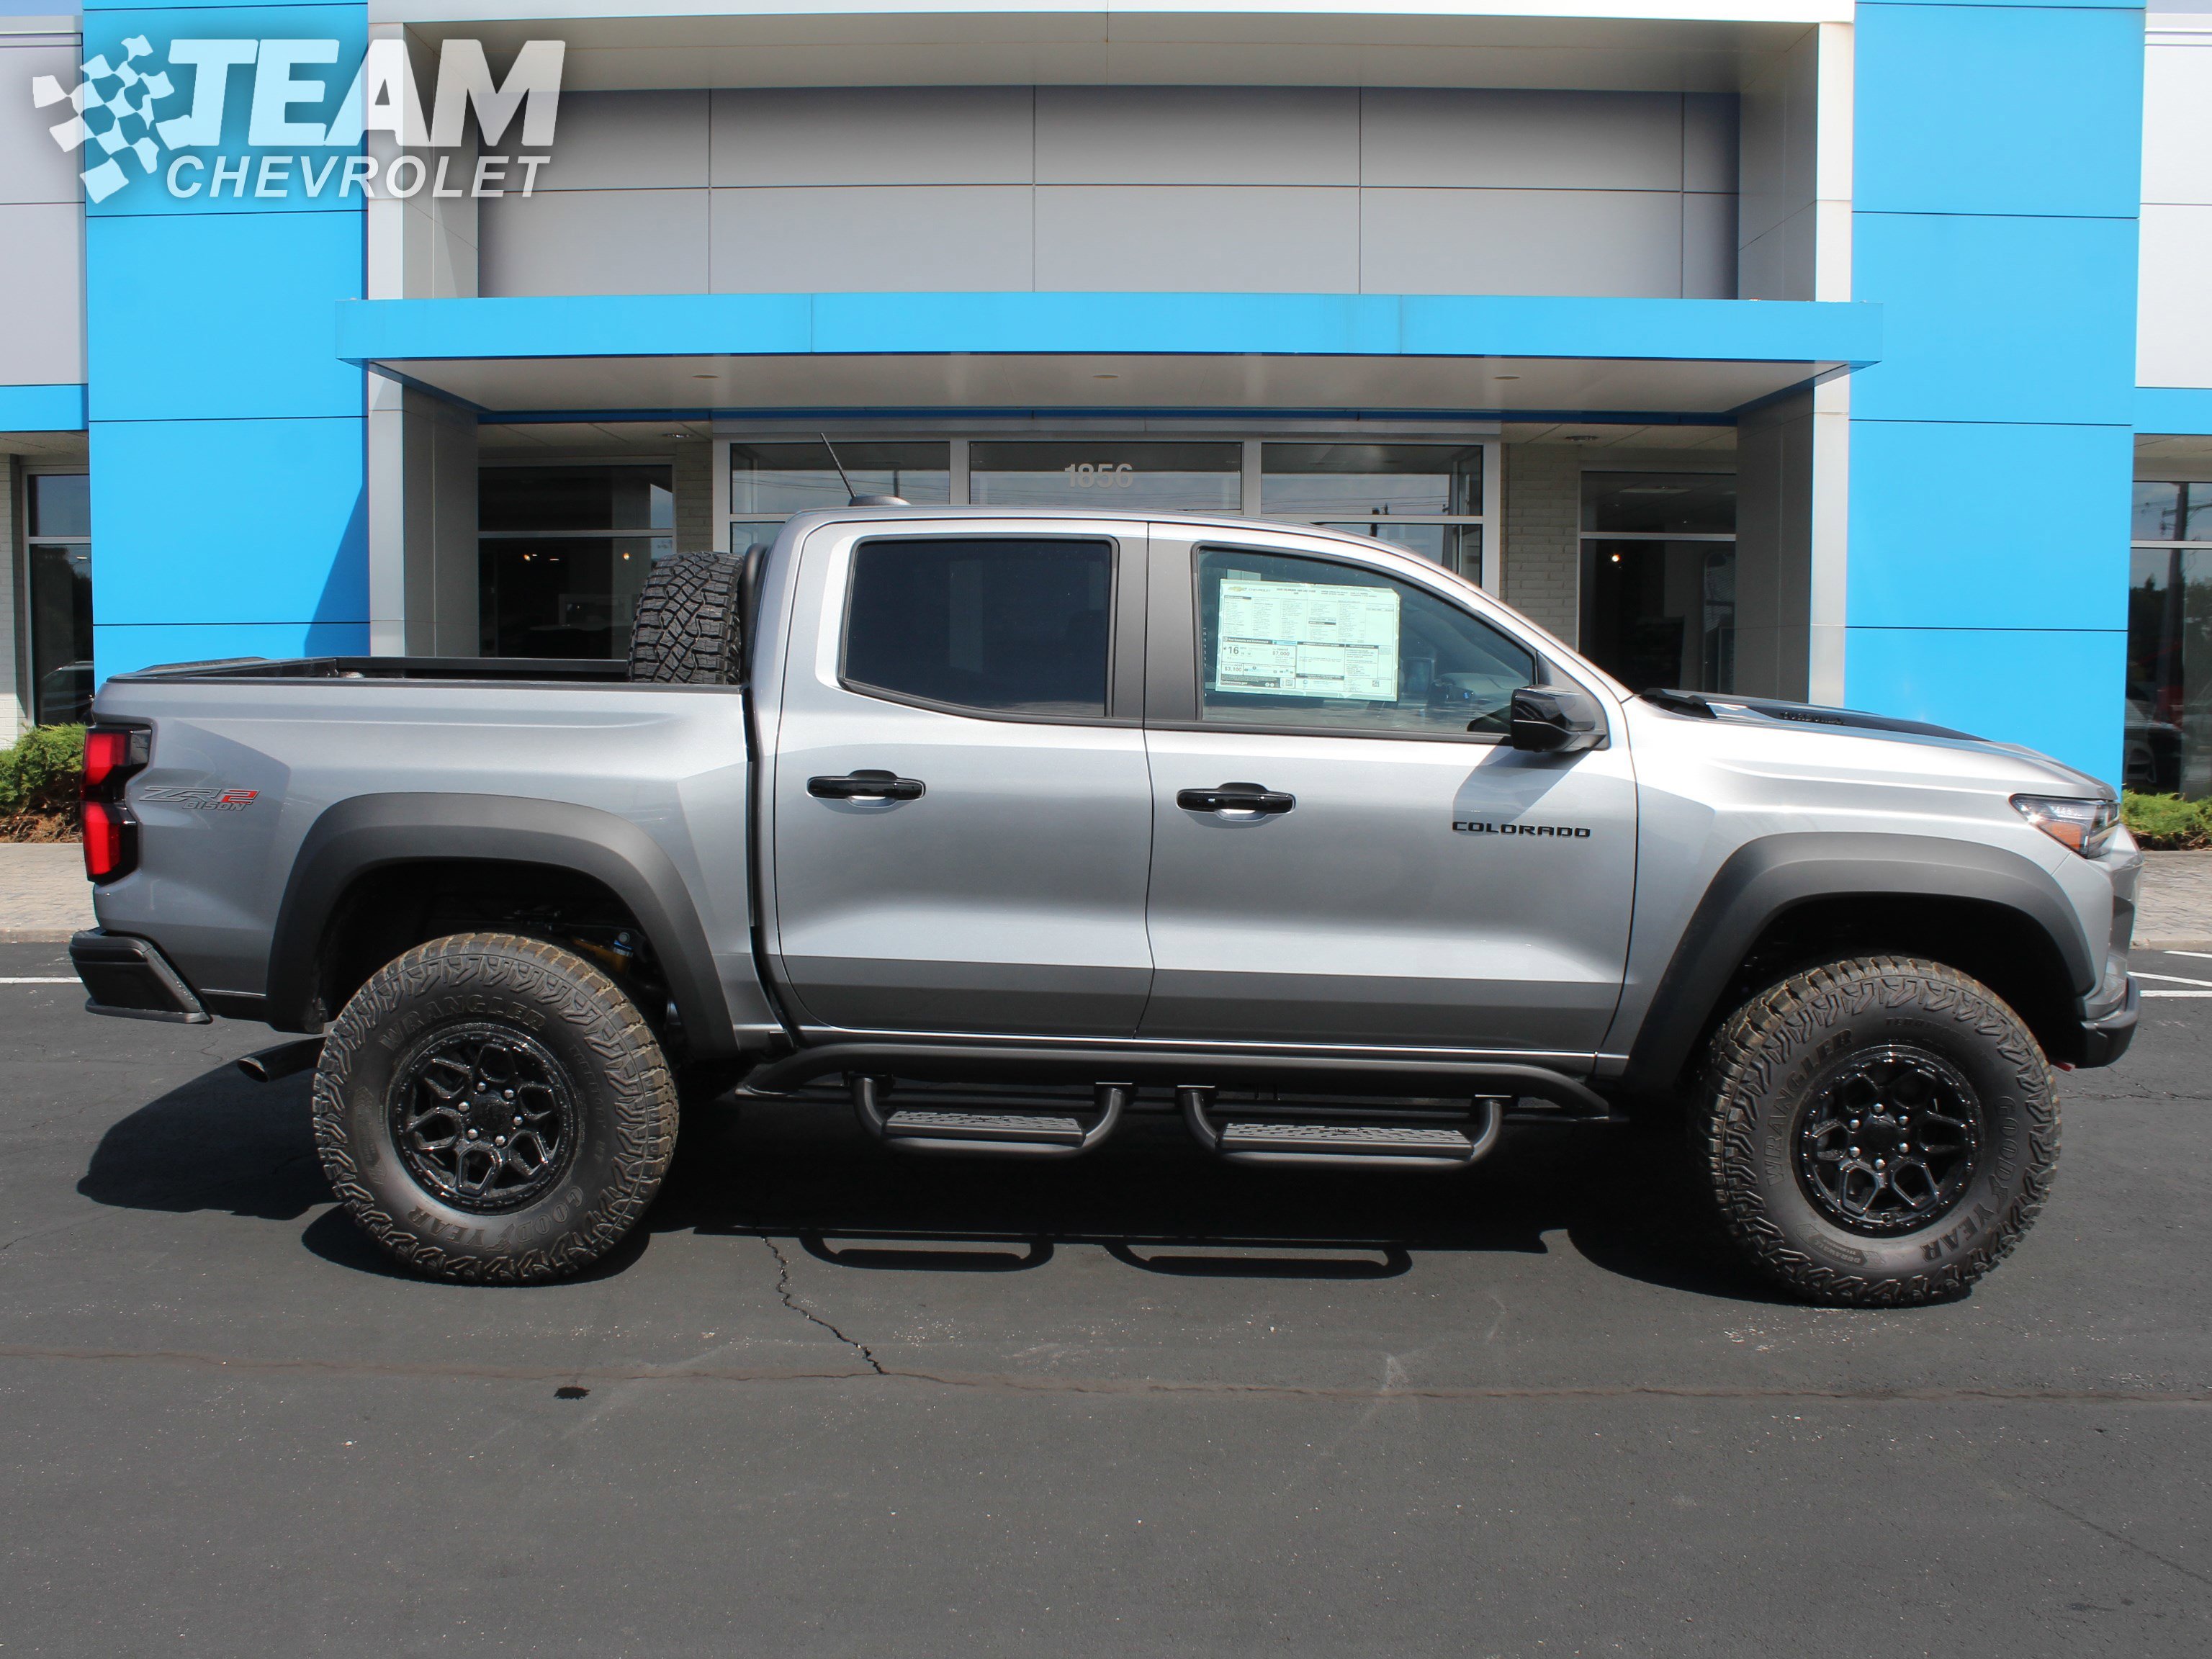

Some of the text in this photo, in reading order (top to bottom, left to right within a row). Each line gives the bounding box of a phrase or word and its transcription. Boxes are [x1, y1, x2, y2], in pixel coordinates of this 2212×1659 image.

[1064, 463, 1133, 488] 1856
[1228, 646, 1239, 655] 16
[139, 786, 260, 805] ZR2
[182, 801, 248, 811] BISON
[1452, 821, 1591, 837] COLORADO
[379, 995, 547, 1051] WRANGLER
[1763, 1028, 1853, 1187] WRANGLER
